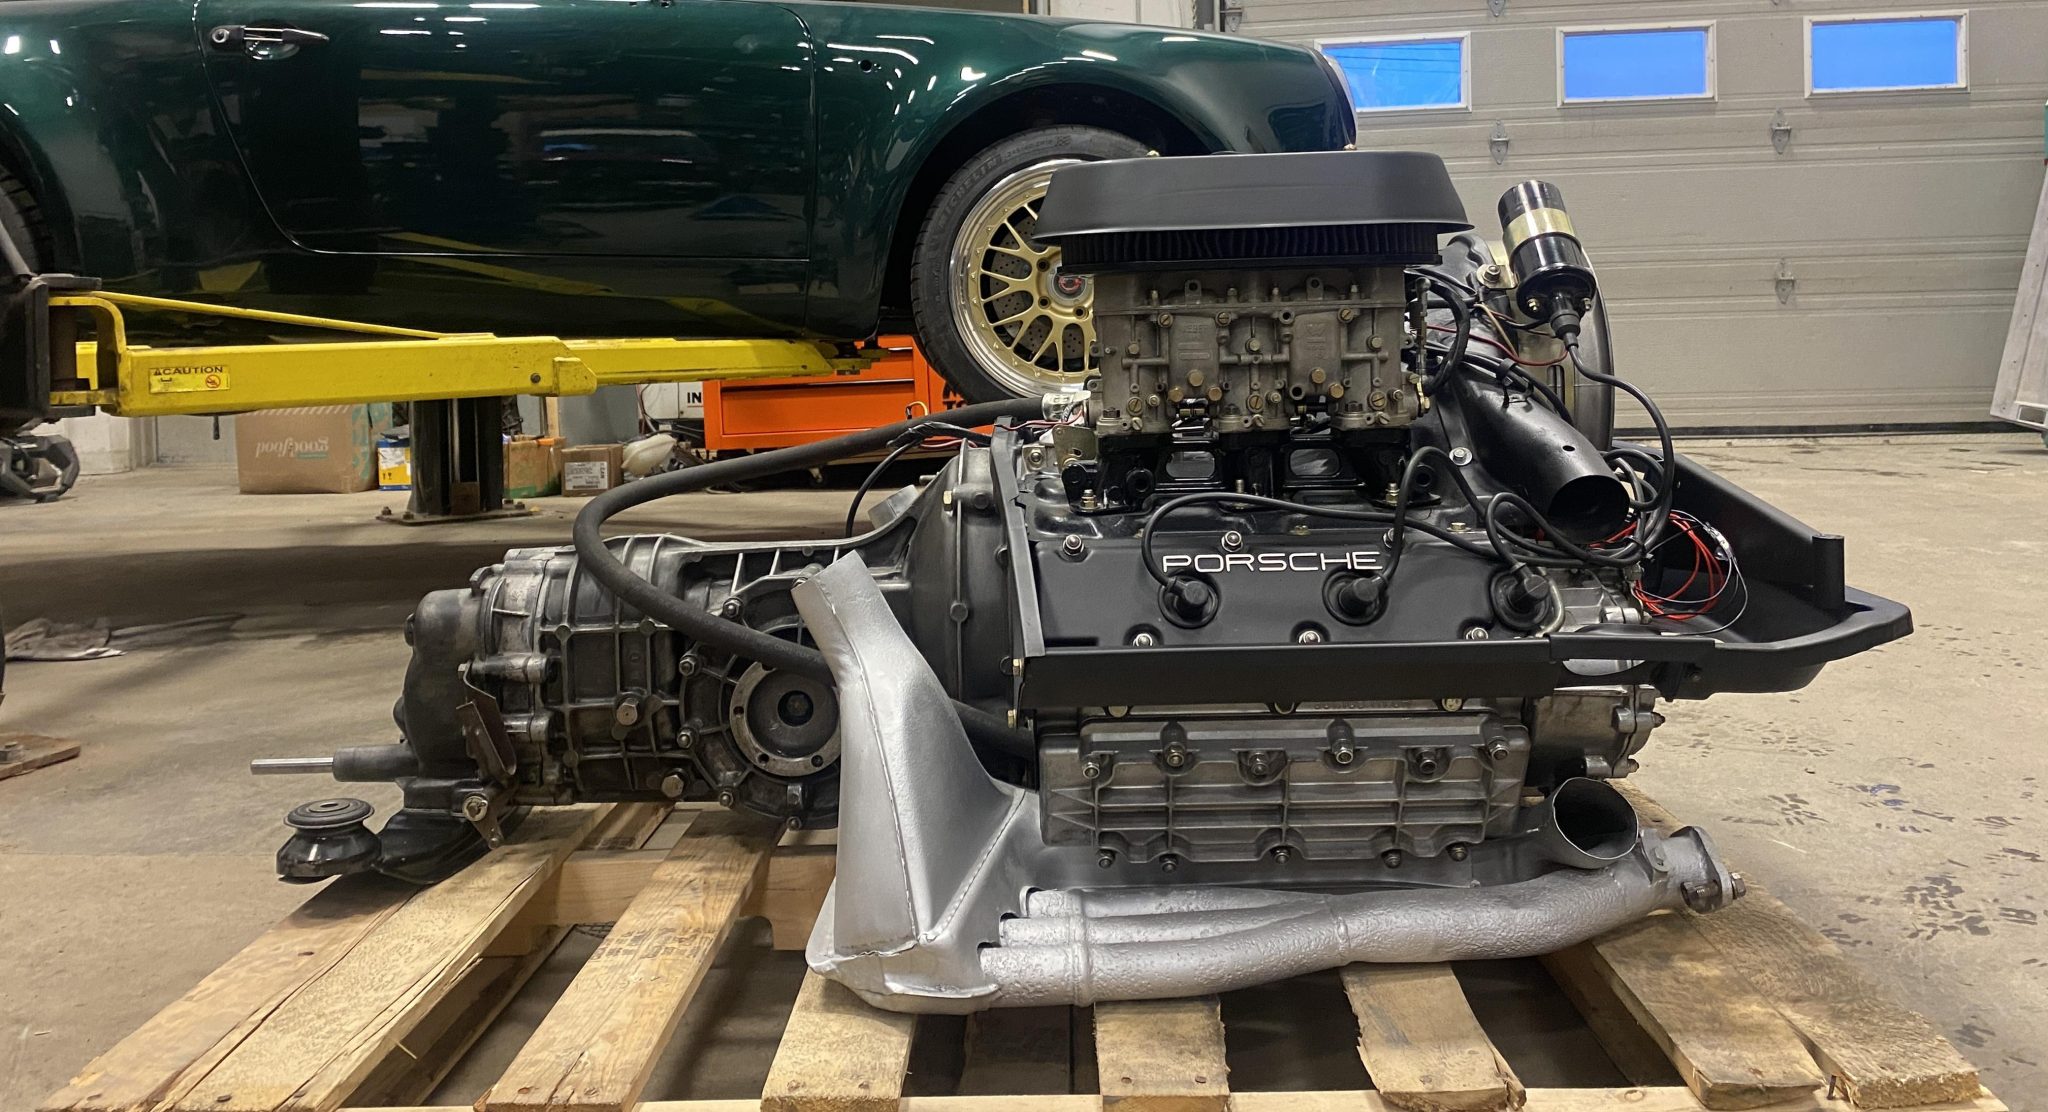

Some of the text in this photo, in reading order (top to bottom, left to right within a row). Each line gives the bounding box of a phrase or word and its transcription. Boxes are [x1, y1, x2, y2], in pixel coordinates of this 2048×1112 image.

[935, 156, 999, 229] MICHELIN
[163, 366, 223, 376] CAUTION
[1162, 551, 1384, 573] PORSCHE
